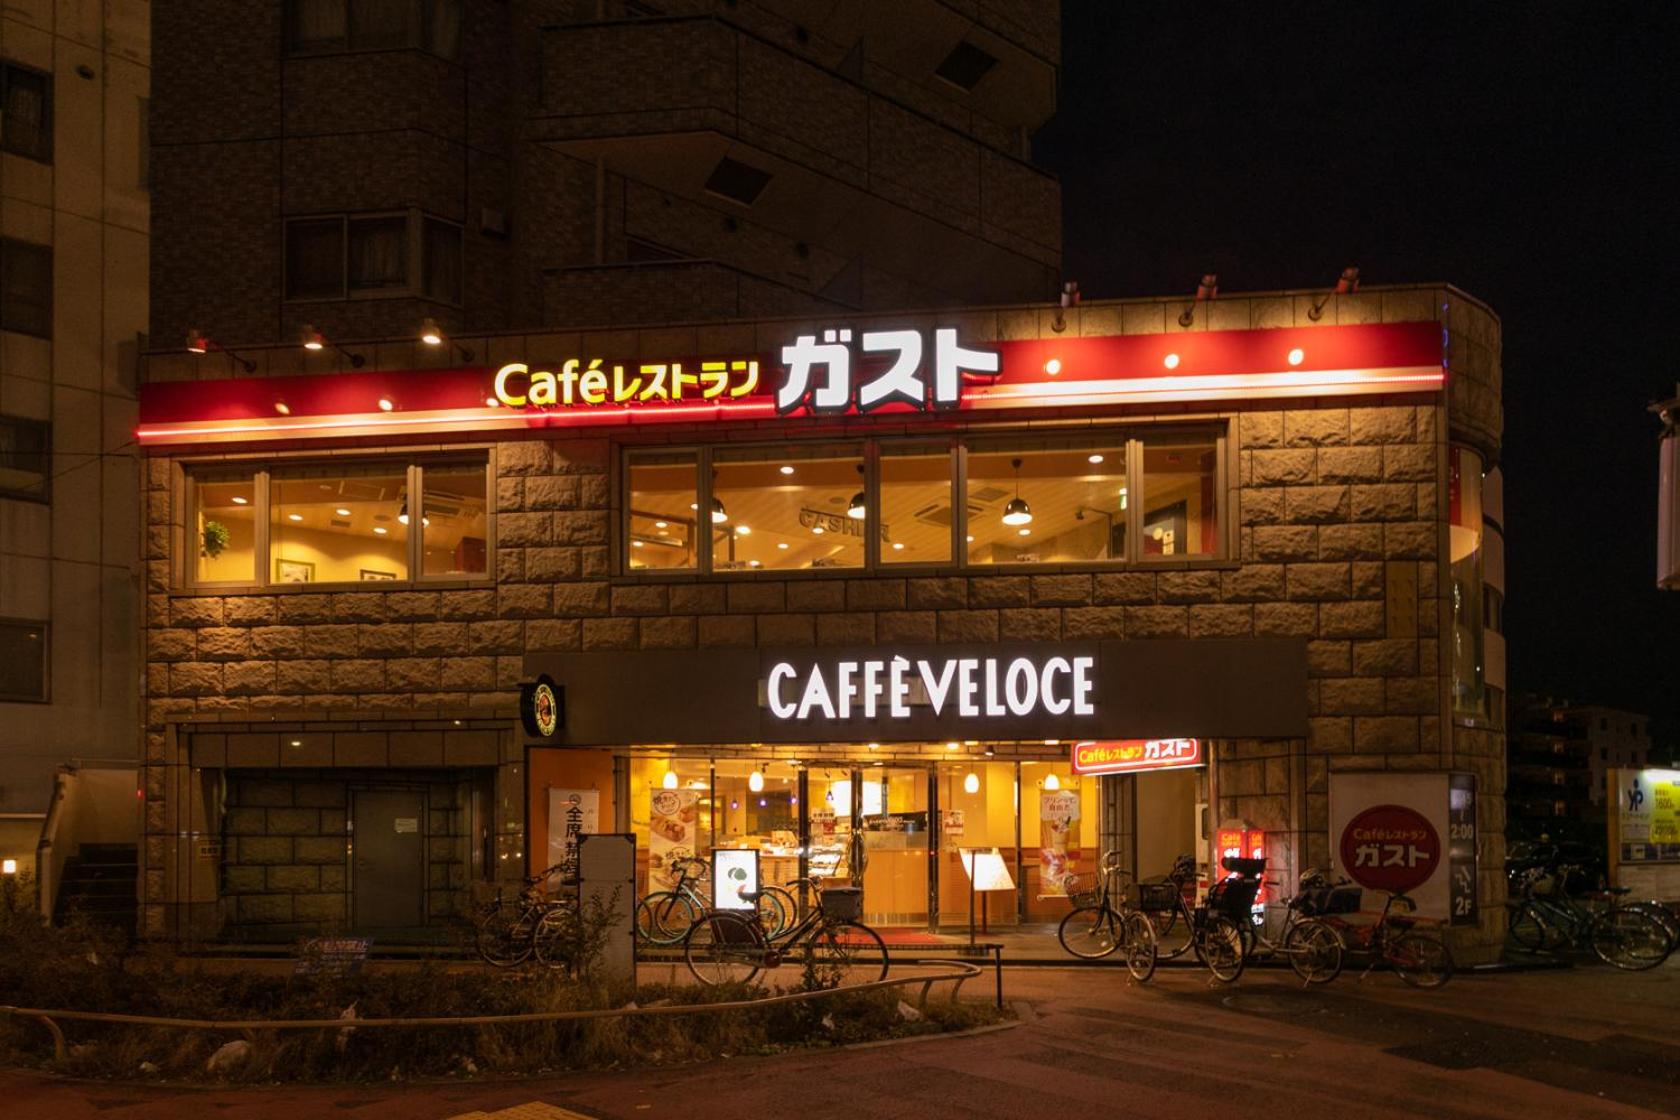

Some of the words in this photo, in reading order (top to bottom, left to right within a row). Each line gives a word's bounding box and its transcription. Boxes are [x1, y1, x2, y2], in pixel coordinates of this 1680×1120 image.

[778, 329, 999, 409] ガスト
[798, 511, 891, 543] CASHIR
[1451, 823, 1474, 840] 2:00
[1354, 843, 1430, 868] ガスト
[1455, 896, 1473, 917] 2F
